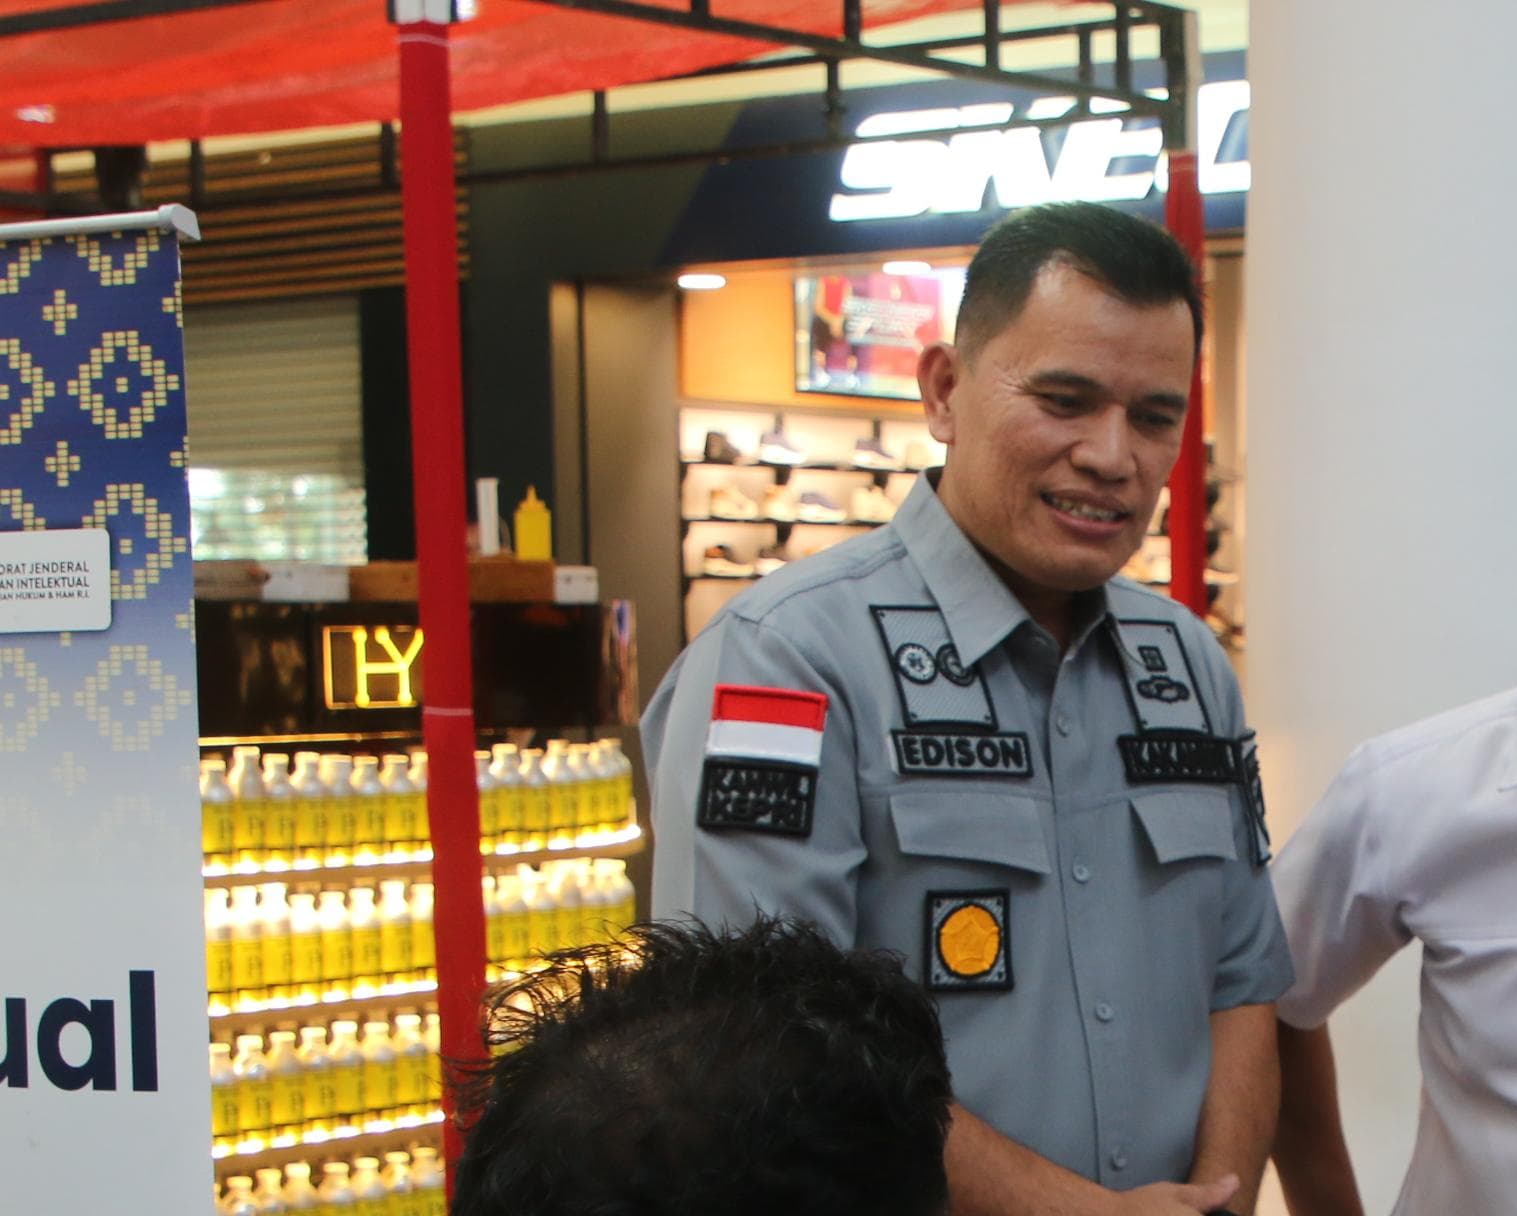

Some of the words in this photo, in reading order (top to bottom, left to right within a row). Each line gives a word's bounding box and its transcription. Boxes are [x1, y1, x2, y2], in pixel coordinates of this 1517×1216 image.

[29, 561, 89, 574] JENDERAL
[17, 577, 89, 589] INTELEKTUAL
[902, 736, 1025, 768] EDISON
